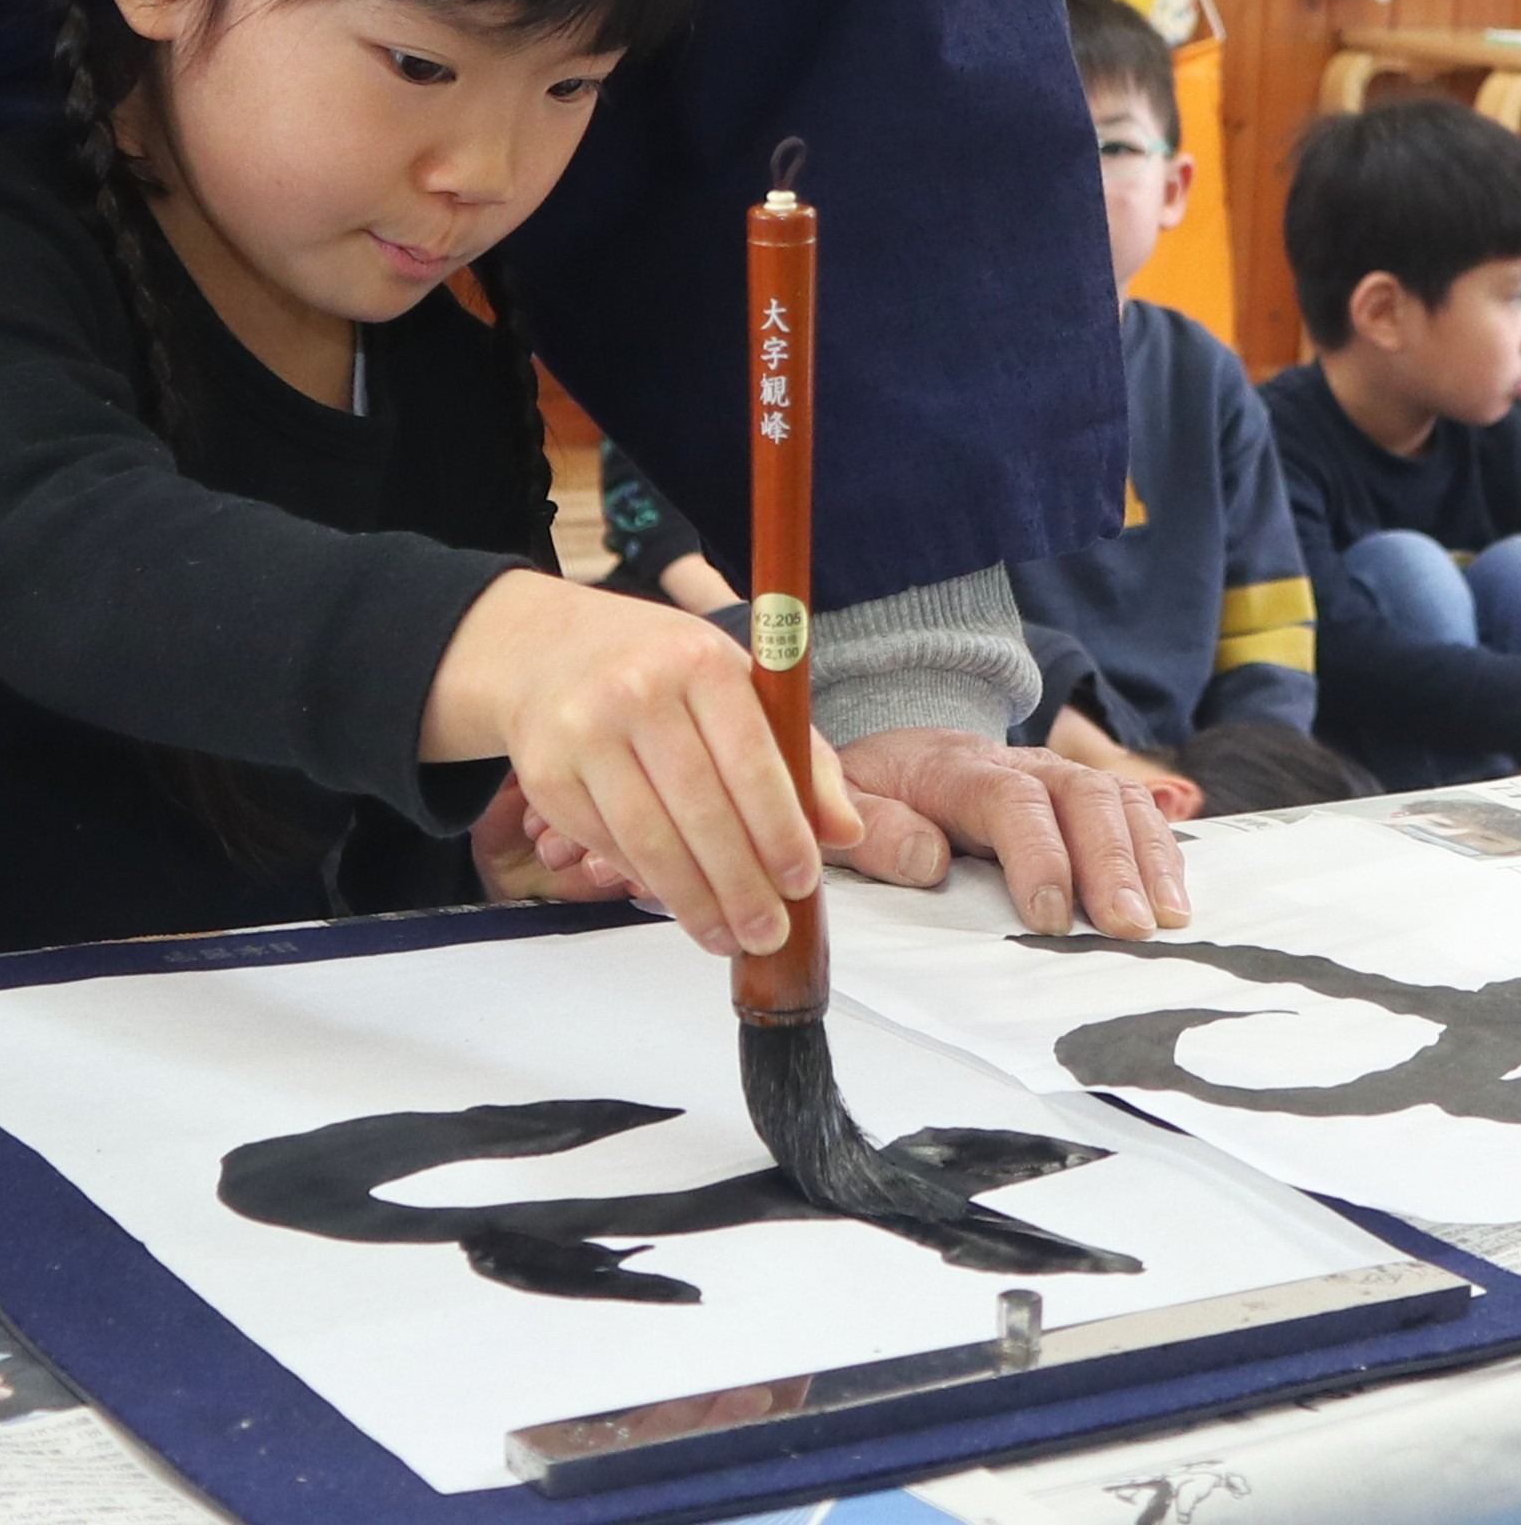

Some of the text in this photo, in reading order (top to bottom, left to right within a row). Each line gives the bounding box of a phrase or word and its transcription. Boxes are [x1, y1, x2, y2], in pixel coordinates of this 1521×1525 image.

[759, 297, 791, 445] 大字観峰
[755, 612, 802, 628] ¥2,205
[757, 646, 799, 660] ¥2,100
